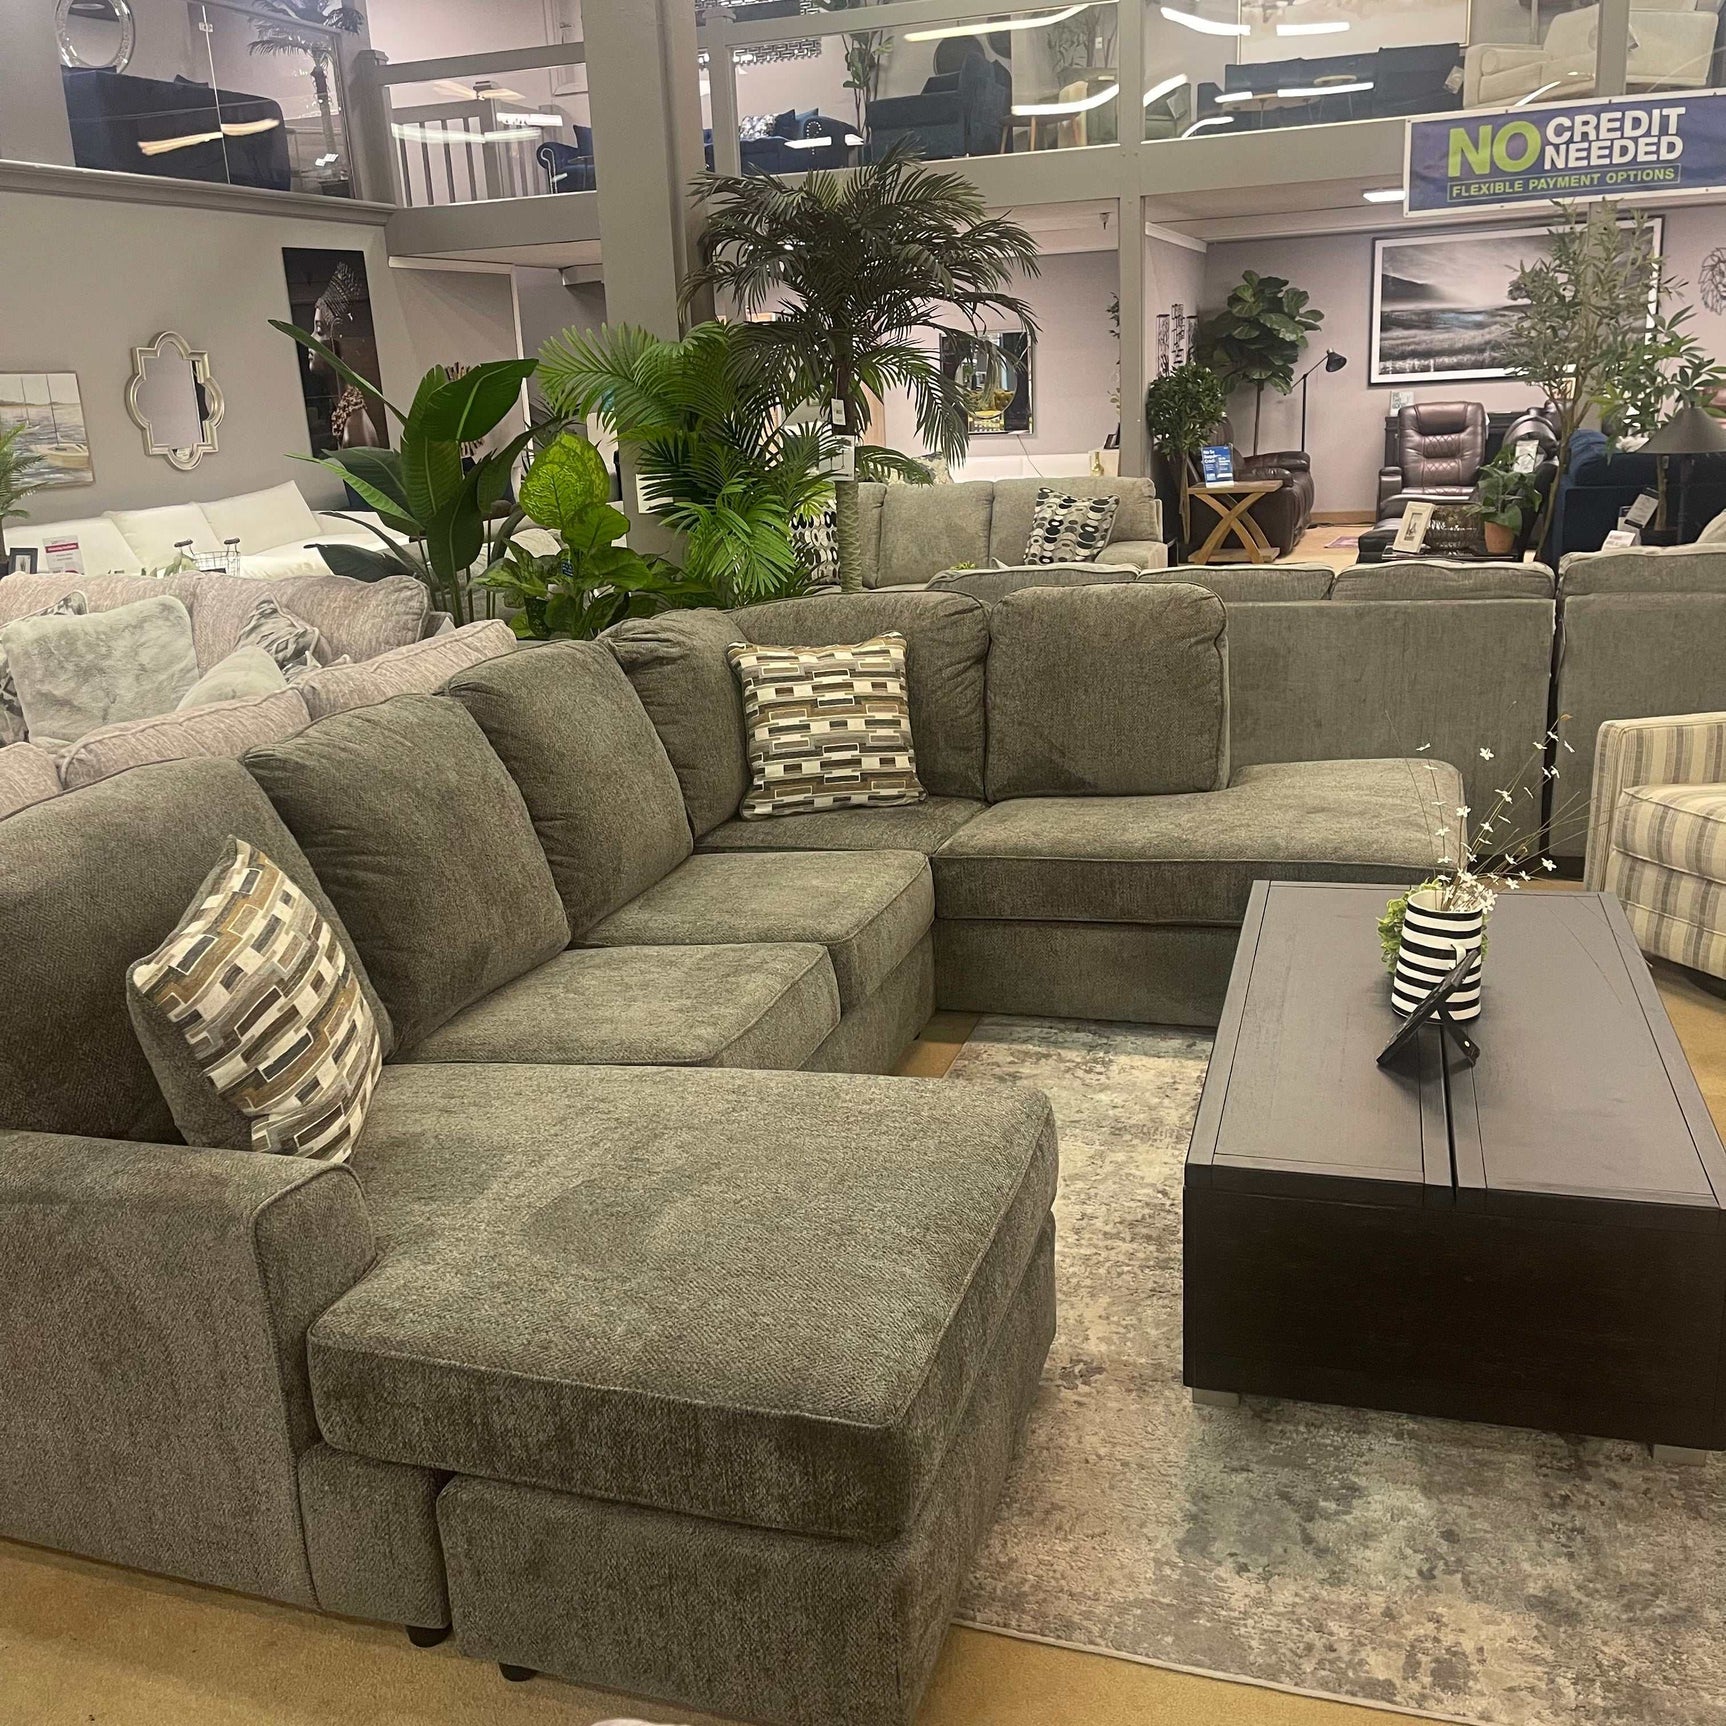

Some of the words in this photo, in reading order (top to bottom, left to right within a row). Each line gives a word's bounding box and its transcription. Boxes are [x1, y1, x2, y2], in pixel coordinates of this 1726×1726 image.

[1448, 121, 1541, 177] NO
[1545, 107, 1686, 144] CREDIT
[1544, 135, 1684, 170] NEEDED
[1452, 180, 1523, 197] FLEXIBLE
[1529, 174, 1601, 190] PAYMENT
[1606, 167, 1675, 183] OPTIONS
